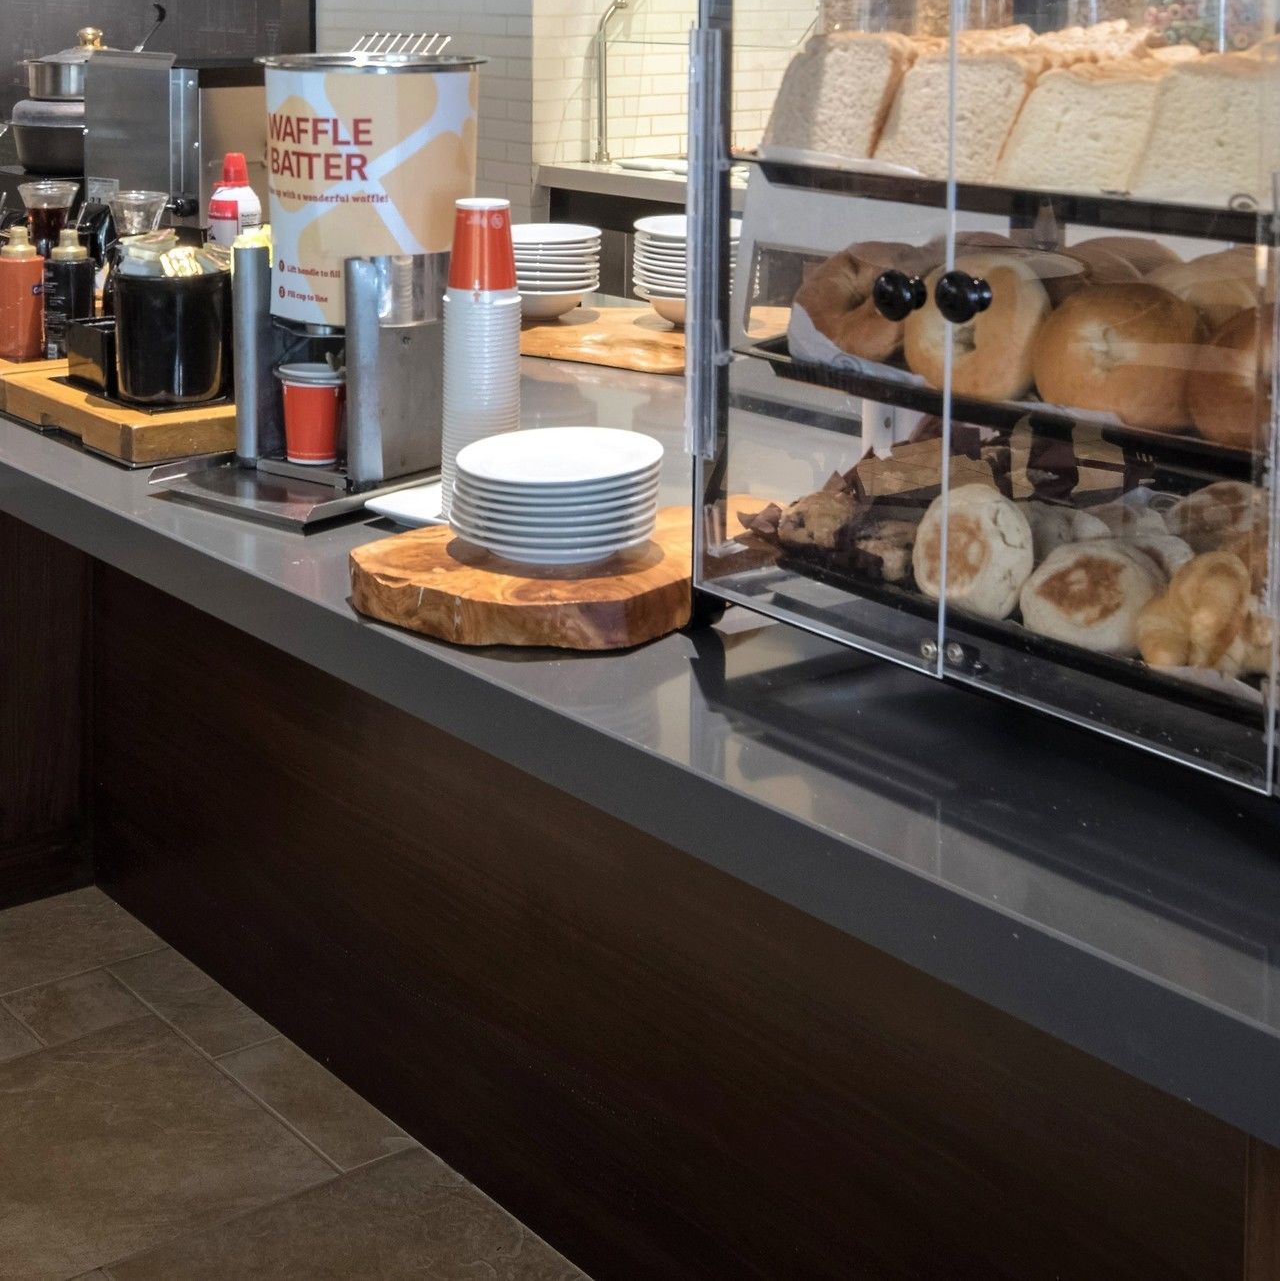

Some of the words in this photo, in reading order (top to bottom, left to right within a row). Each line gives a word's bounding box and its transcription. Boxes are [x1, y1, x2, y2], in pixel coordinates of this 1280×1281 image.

[269, 113, 373, 146] WAFFLE
[271, 147, 368, 181] BATTER
[283, 191, 295, 199] with
[303, 193, 350, 203] wonderful
[352, 194, 389, 203] waffle!
[287, 265, 297, 273] Lift
[298, 267, 319, 277] handle
[330, 270, 341, 279] fill
[287, 290, 296, 298] Fill
[296, 293, 306, 301] cup
[315, 295, 328, 303] line
